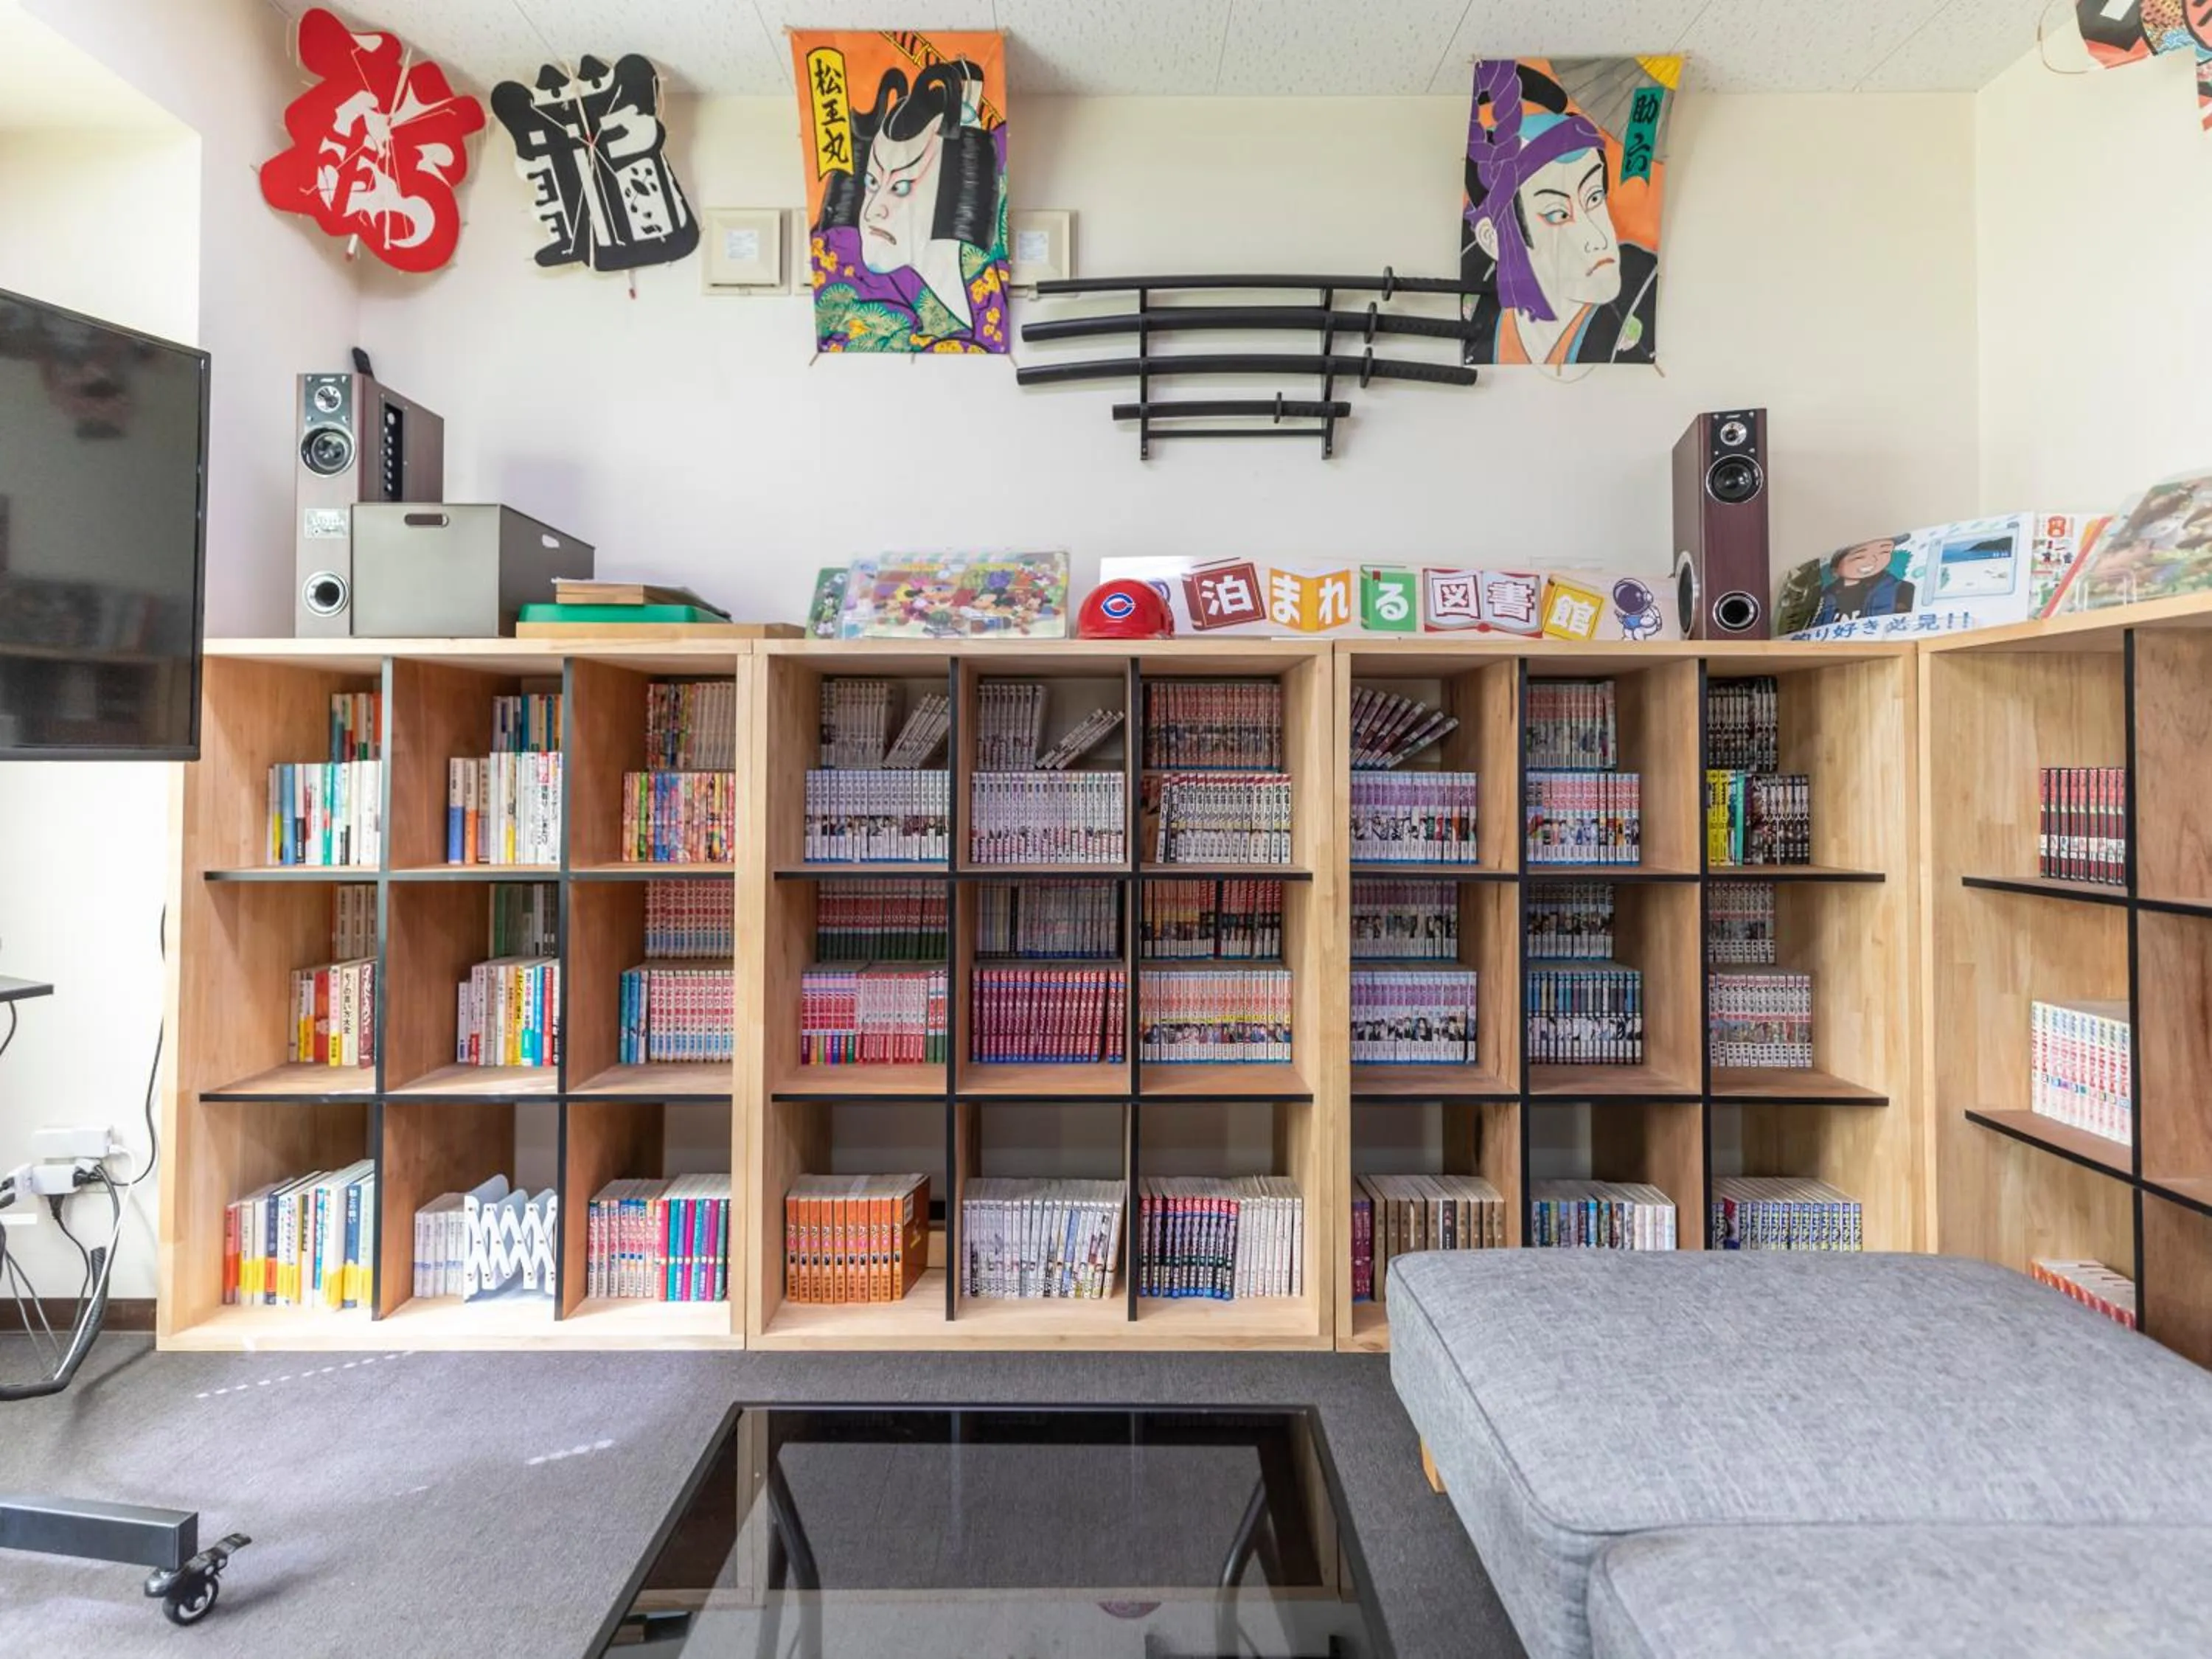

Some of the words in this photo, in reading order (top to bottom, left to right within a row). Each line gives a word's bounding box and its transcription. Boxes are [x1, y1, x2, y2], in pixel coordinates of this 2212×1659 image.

[814, 58, 849, 164] 松王丸
[1624, 94, 1659, 173] 助六
[1201, 574, 1595, 636] 泊まれる図書館
